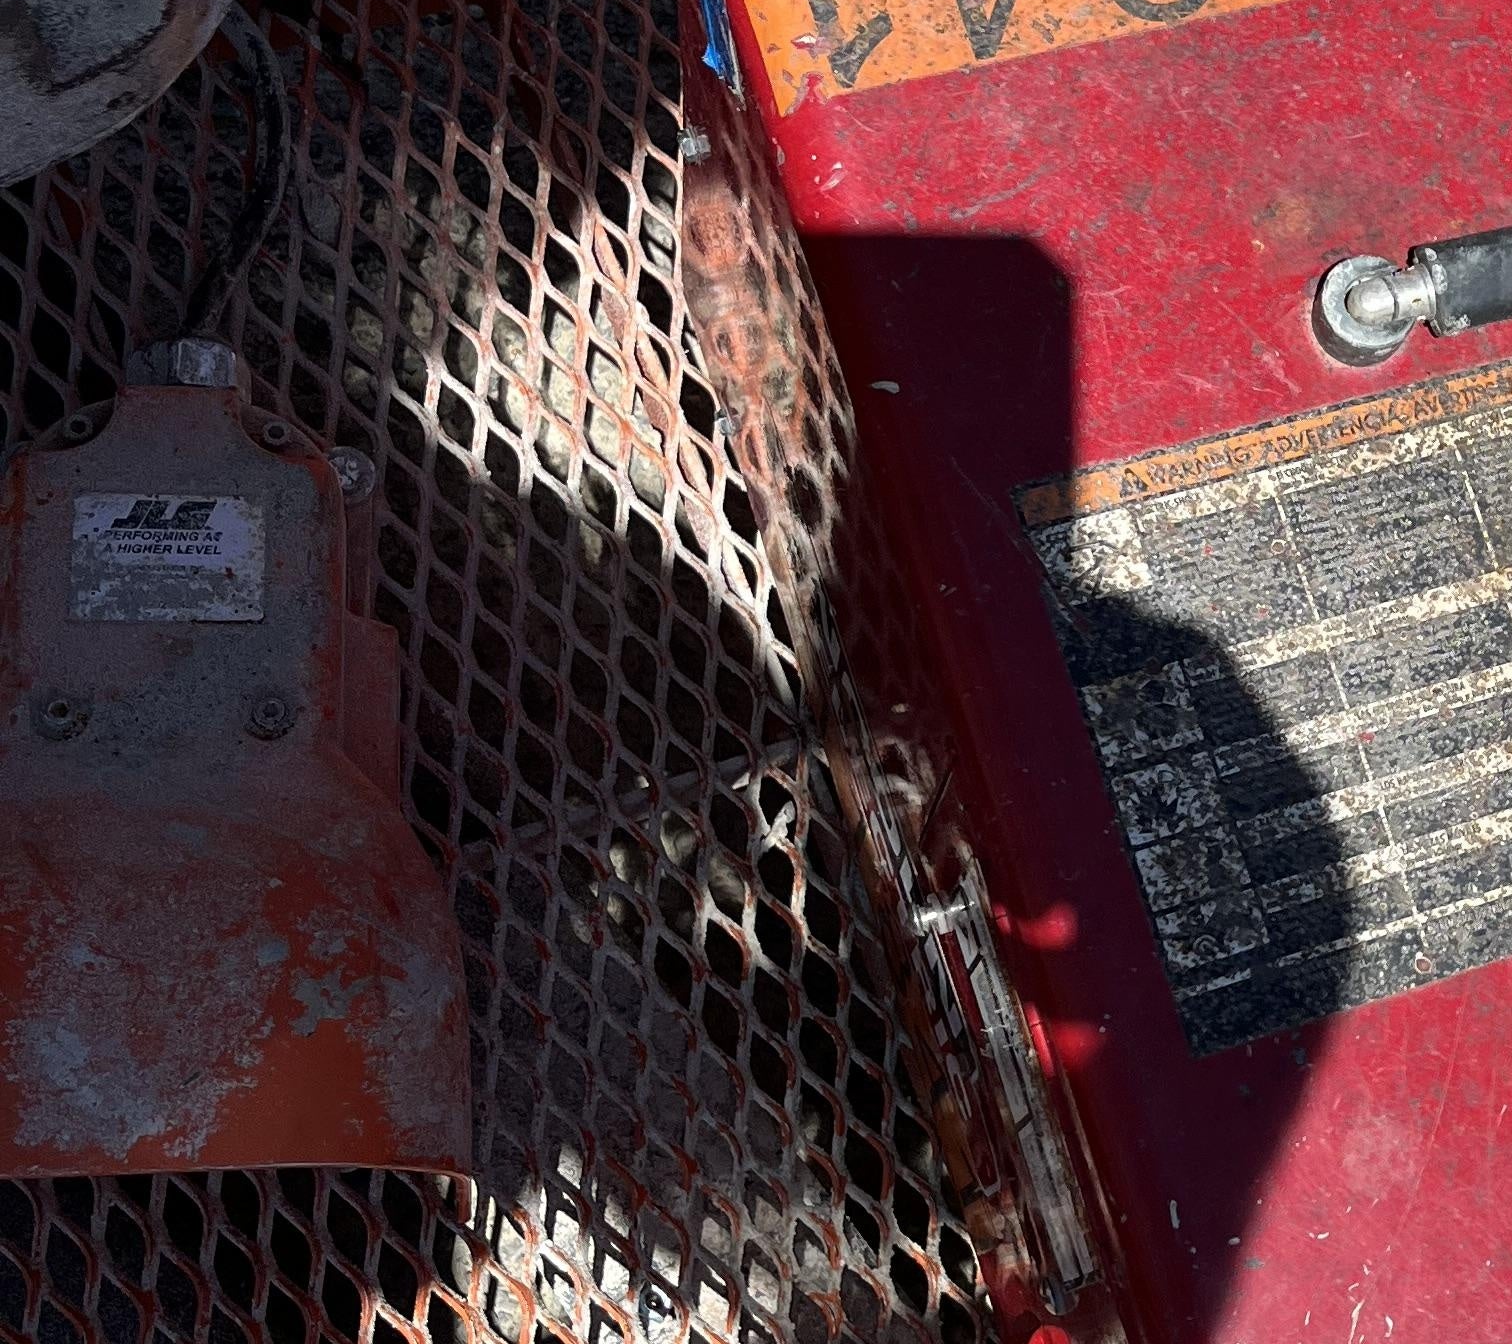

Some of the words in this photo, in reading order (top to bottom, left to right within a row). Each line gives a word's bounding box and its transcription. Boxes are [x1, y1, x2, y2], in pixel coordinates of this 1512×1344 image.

[111, 499, 217, 529] JLG
[116, 543, 172, 554] HIGHER
[176, 543, 222, 554] LEVEL
